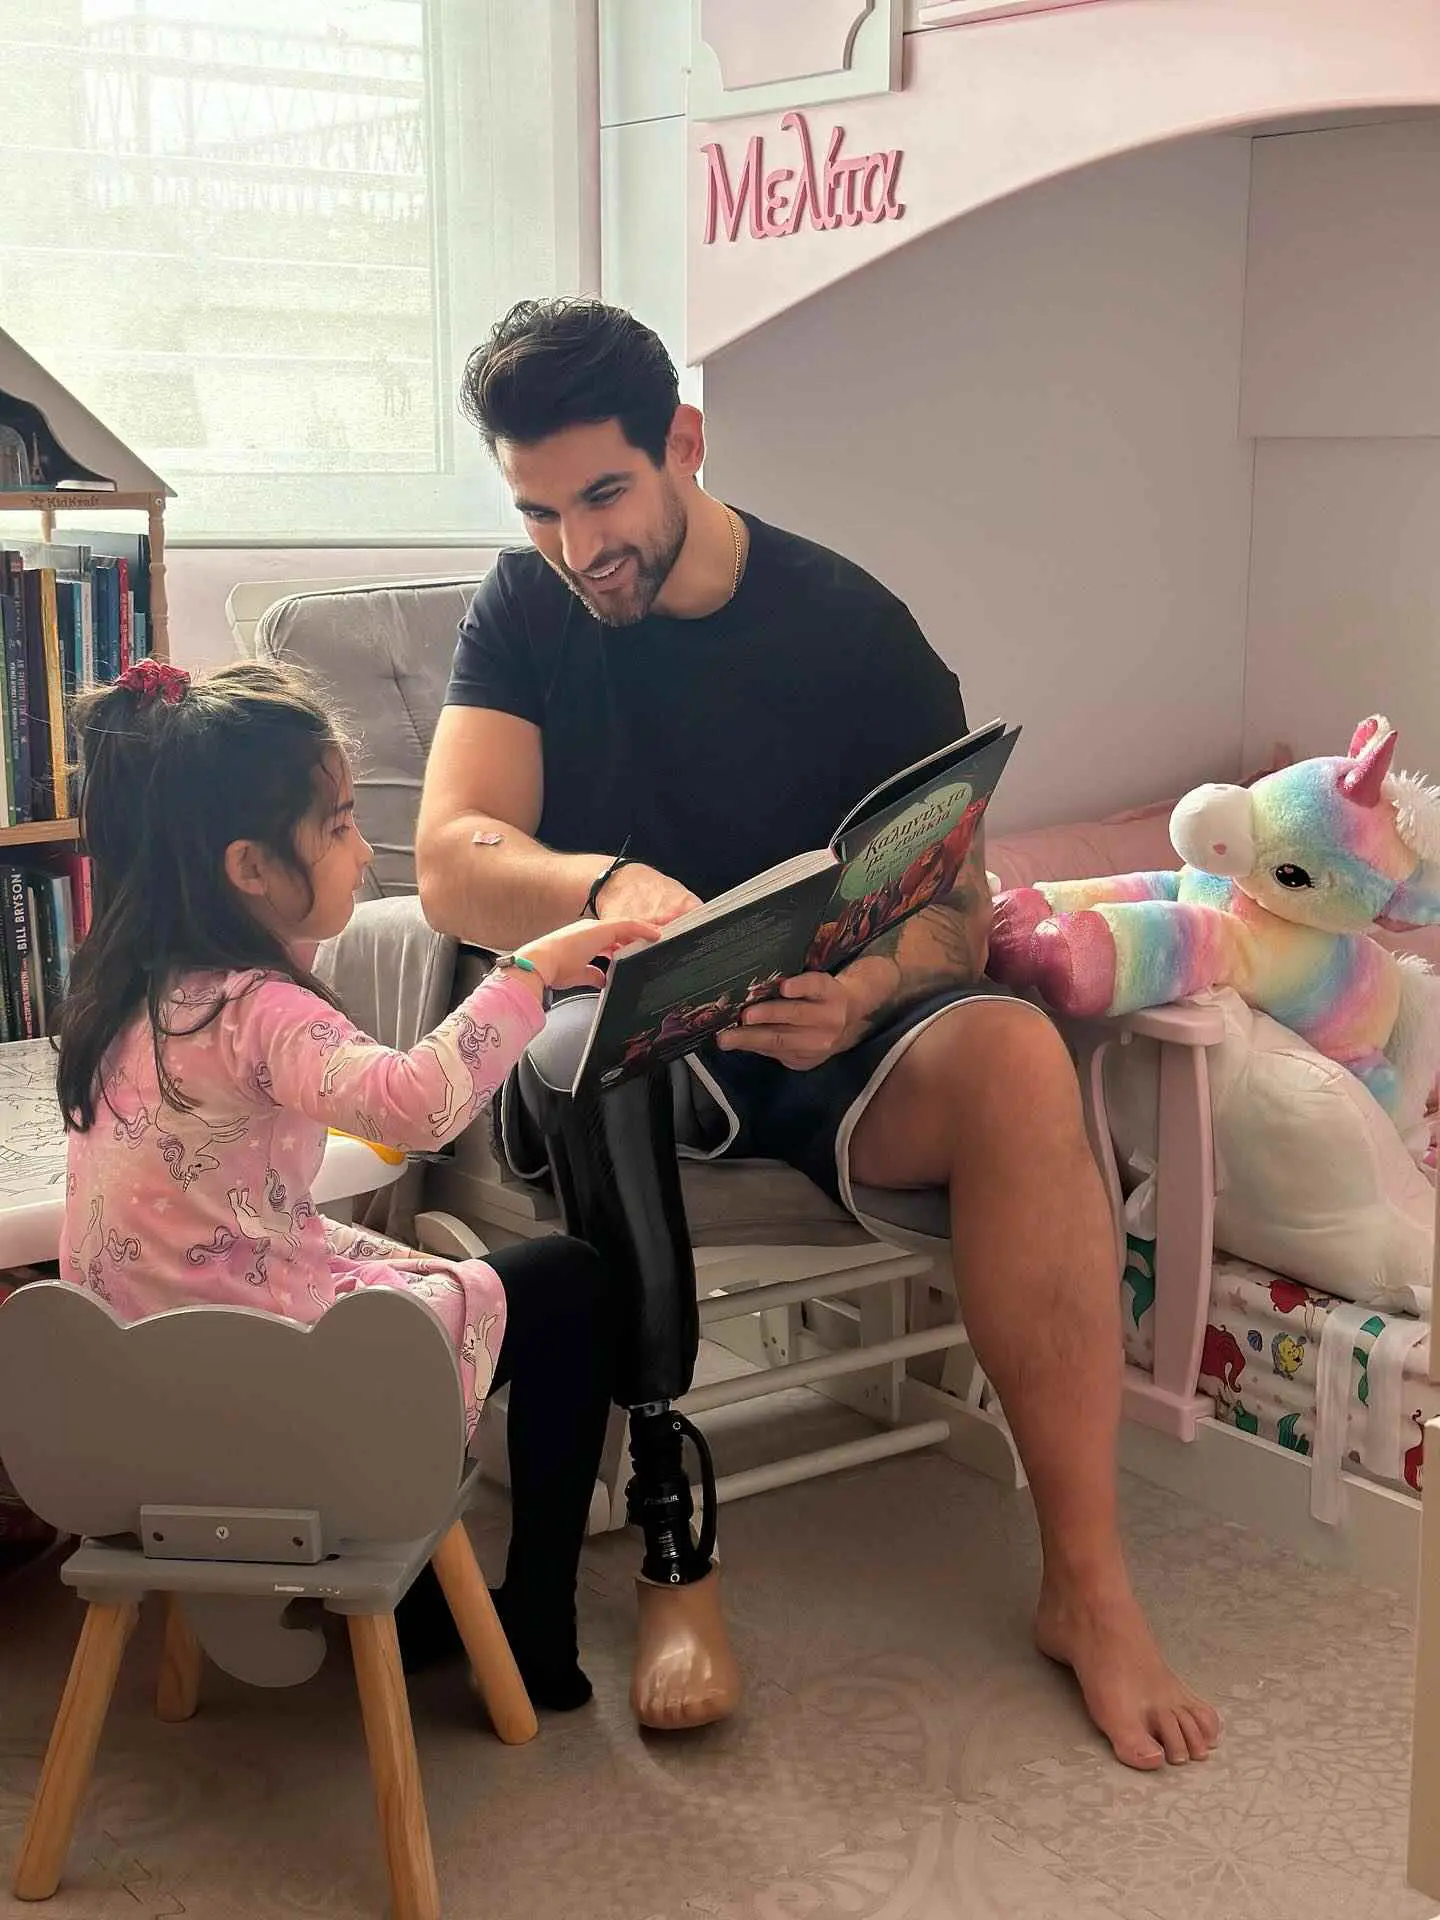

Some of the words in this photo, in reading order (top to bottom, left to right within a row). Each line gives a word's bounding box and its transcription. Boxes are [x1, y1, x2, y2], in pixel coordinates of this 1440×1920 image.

[701, 112, 906, 244] Μελίτα
[47, 495, 99, 508] KidKraft
[864, 787, 967, 862] Καληνύχτα
[11, 871, 25, 924] BRYSON
[17, 925, 28, 951] BILL
